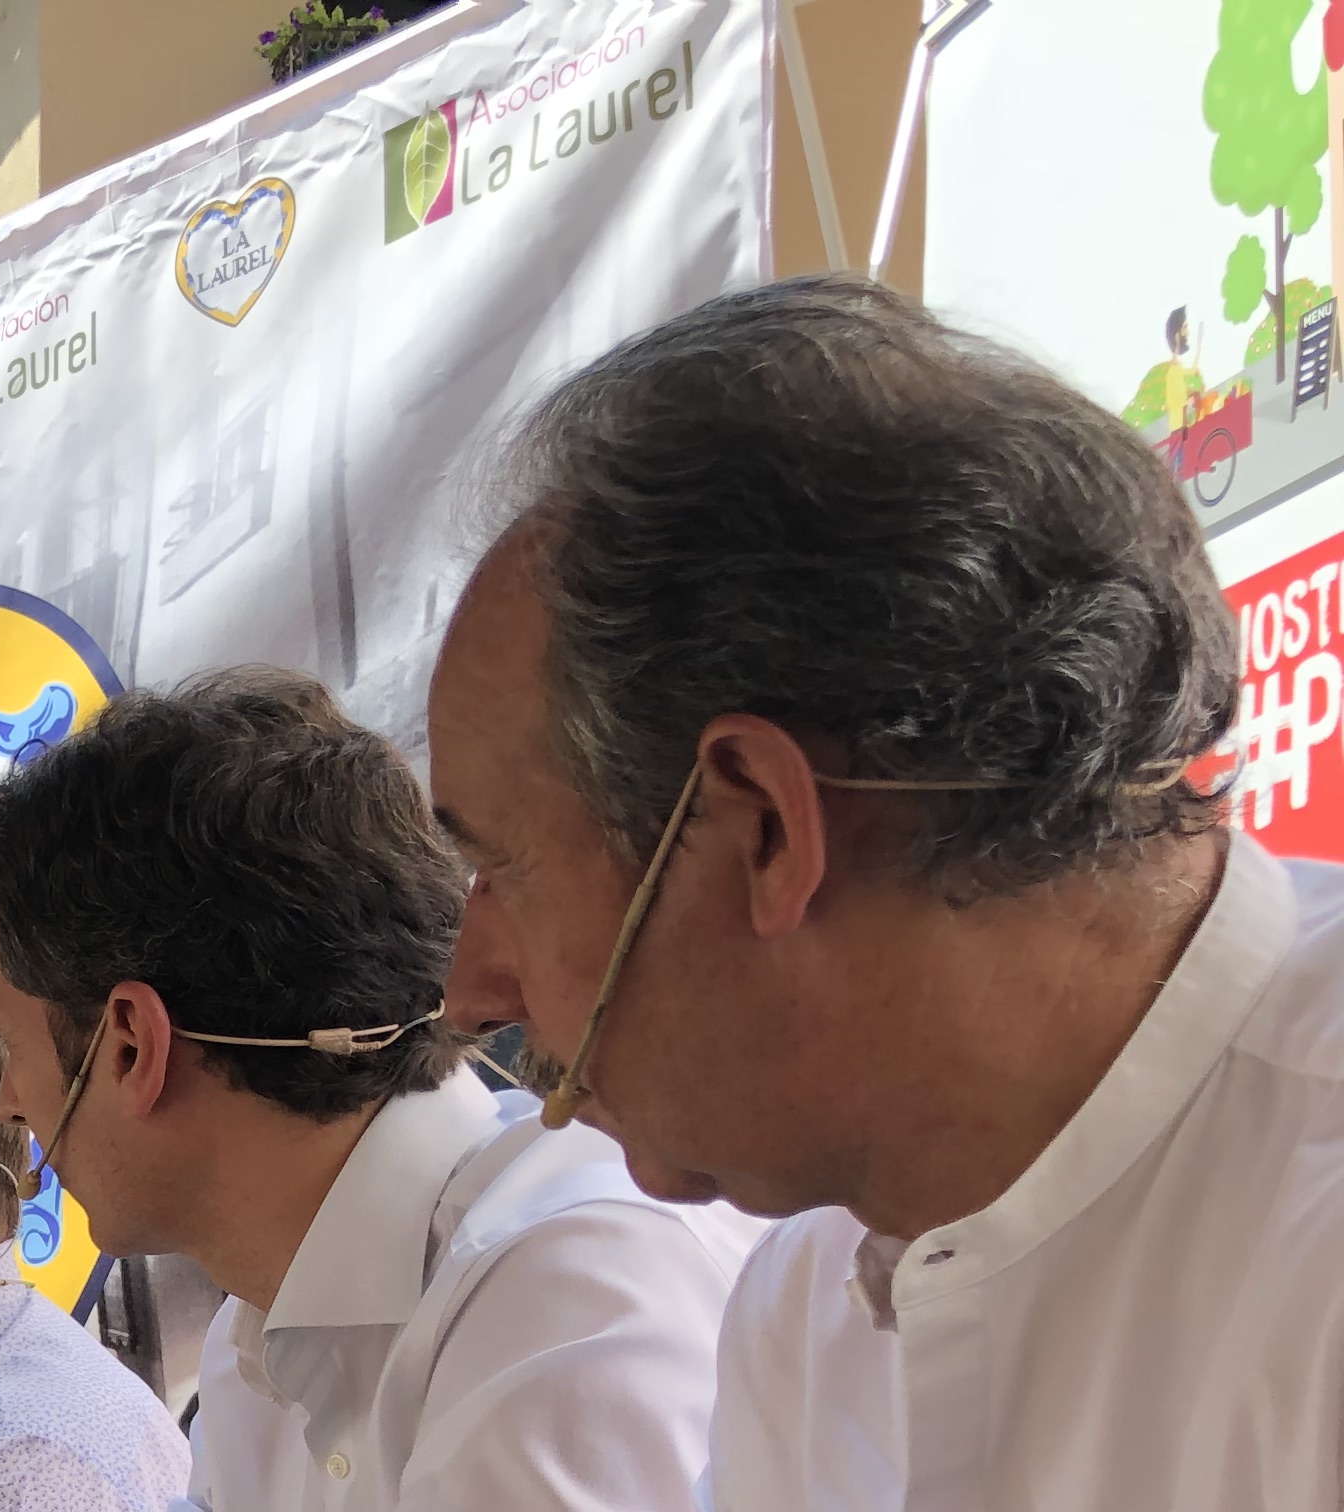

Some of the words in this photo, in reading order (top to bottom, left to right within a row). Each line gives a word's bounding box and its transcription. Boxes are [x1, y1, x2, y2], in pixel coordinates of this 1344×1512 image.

[461, 145, 513, 205] La
[528, 40, 694, 171] Laurel
[222, 230, 251, 259] LA
[196, 245, 273, 294] LAUREL
[1303, 302, 1334, 330] MENU
